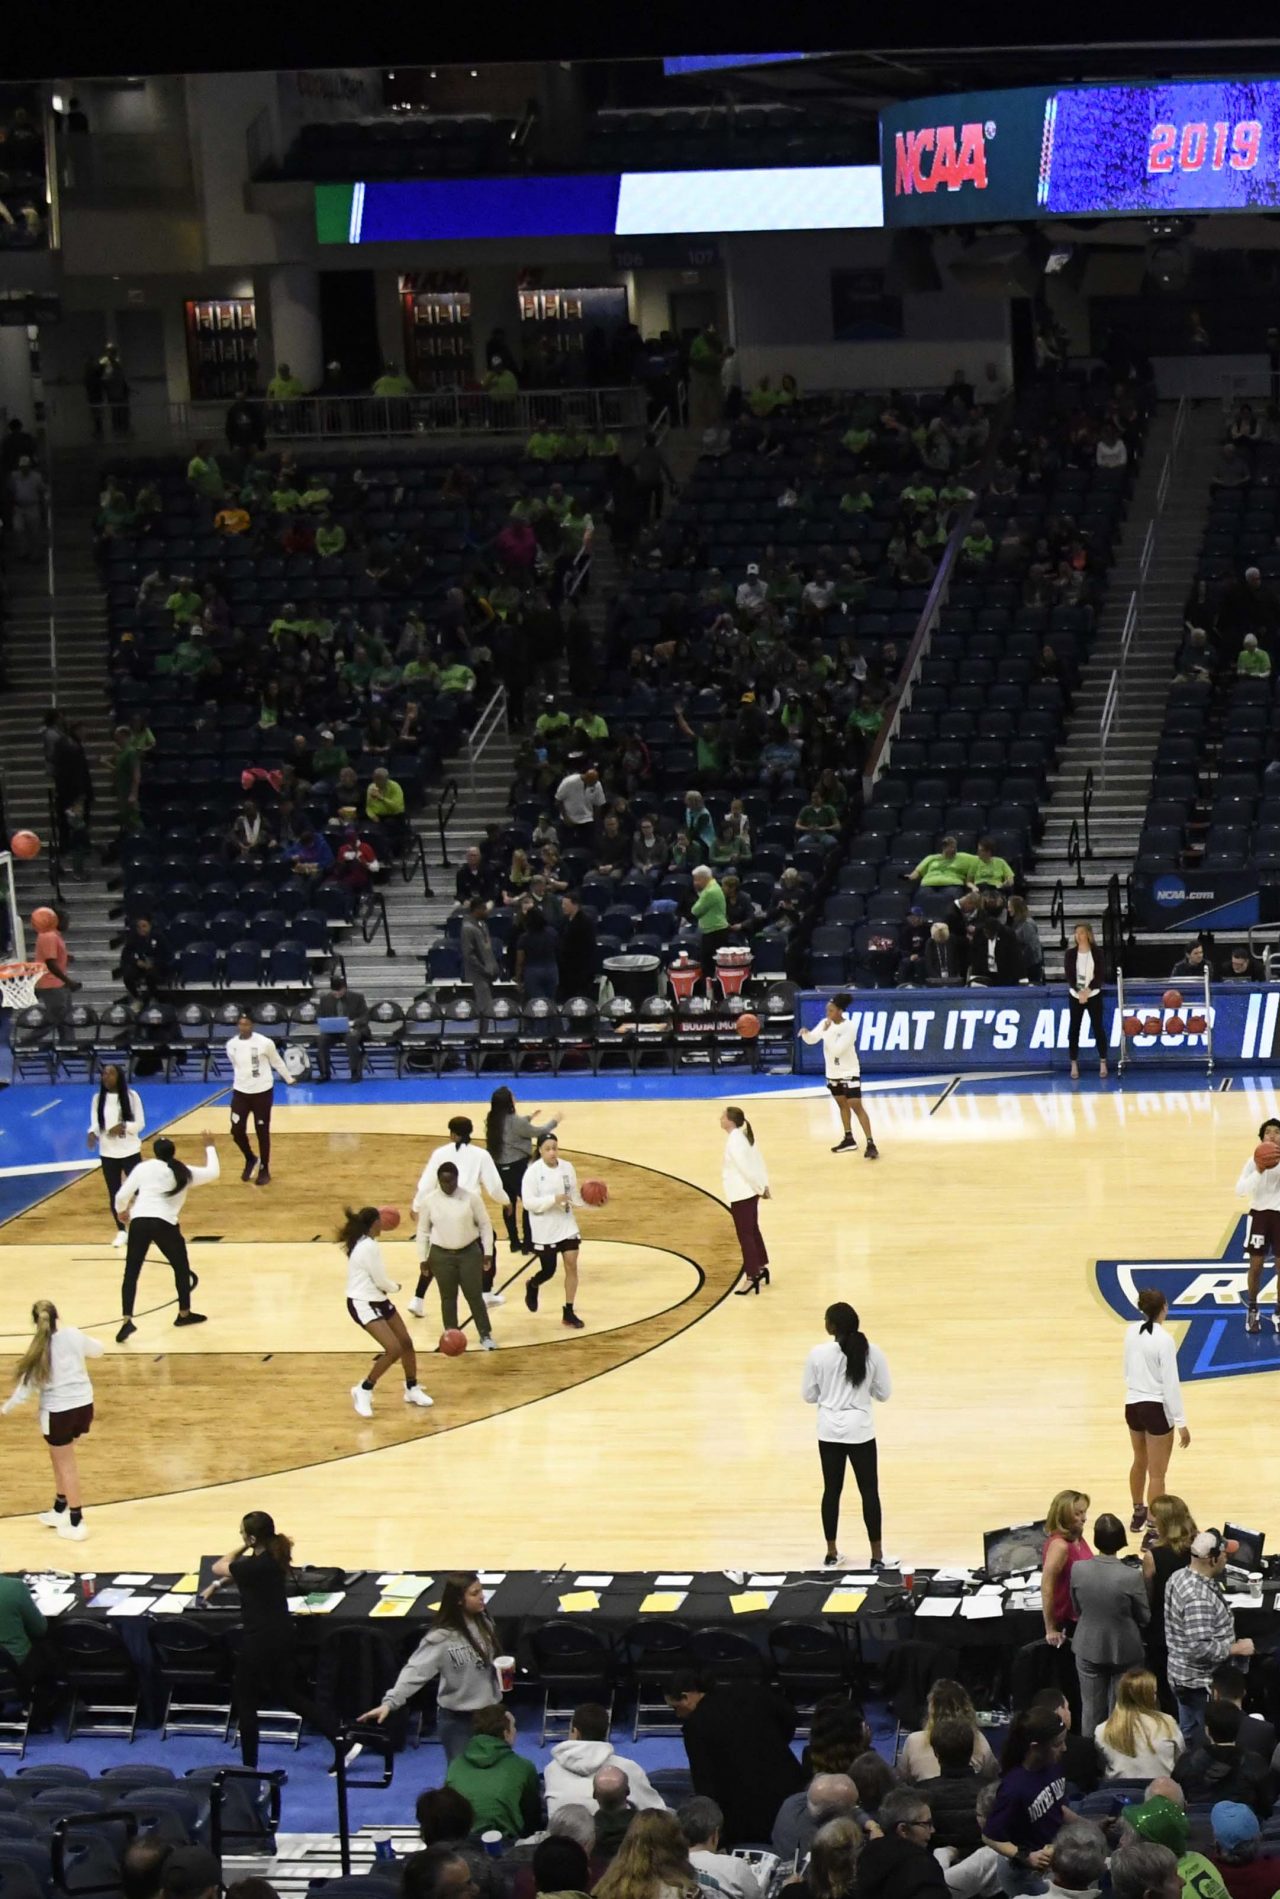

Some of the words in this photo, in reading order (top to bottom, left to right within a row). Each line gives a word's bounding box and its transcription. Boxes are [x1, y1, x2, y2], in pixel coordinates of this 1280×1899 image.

[1147, 120, 1263, 173] 2019
[1157, 890, 1215, 900] NCAA.com
[943, 1009, 1021, 1050] IT'S
